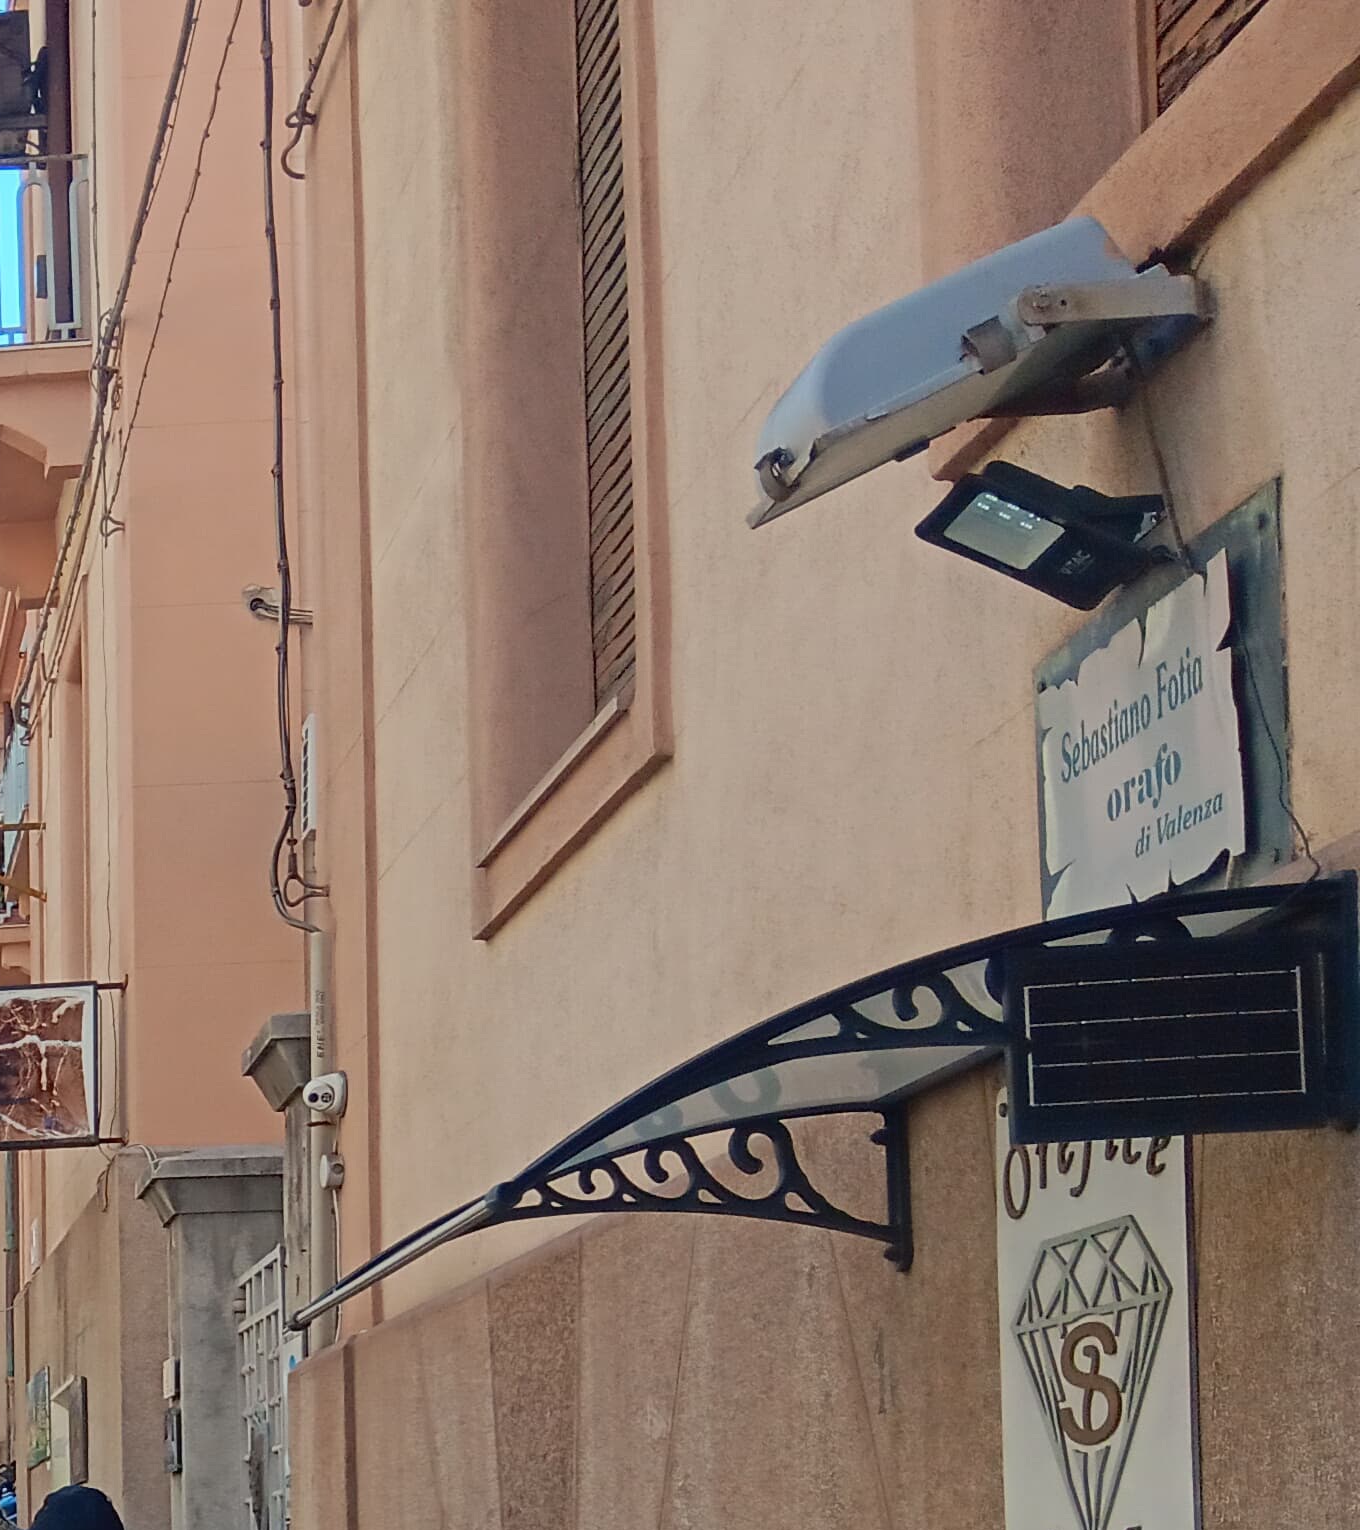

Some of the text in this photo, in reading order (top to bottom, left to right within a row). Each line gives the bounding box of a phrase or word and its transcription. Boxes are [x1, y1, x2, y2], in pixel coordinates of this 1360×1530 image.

[1060, 647, 1203, 784] Sebastiano Fotia
[1106, 743, 1181, 822] orafo
[1135, 793, 1223, 858] di Valenza
